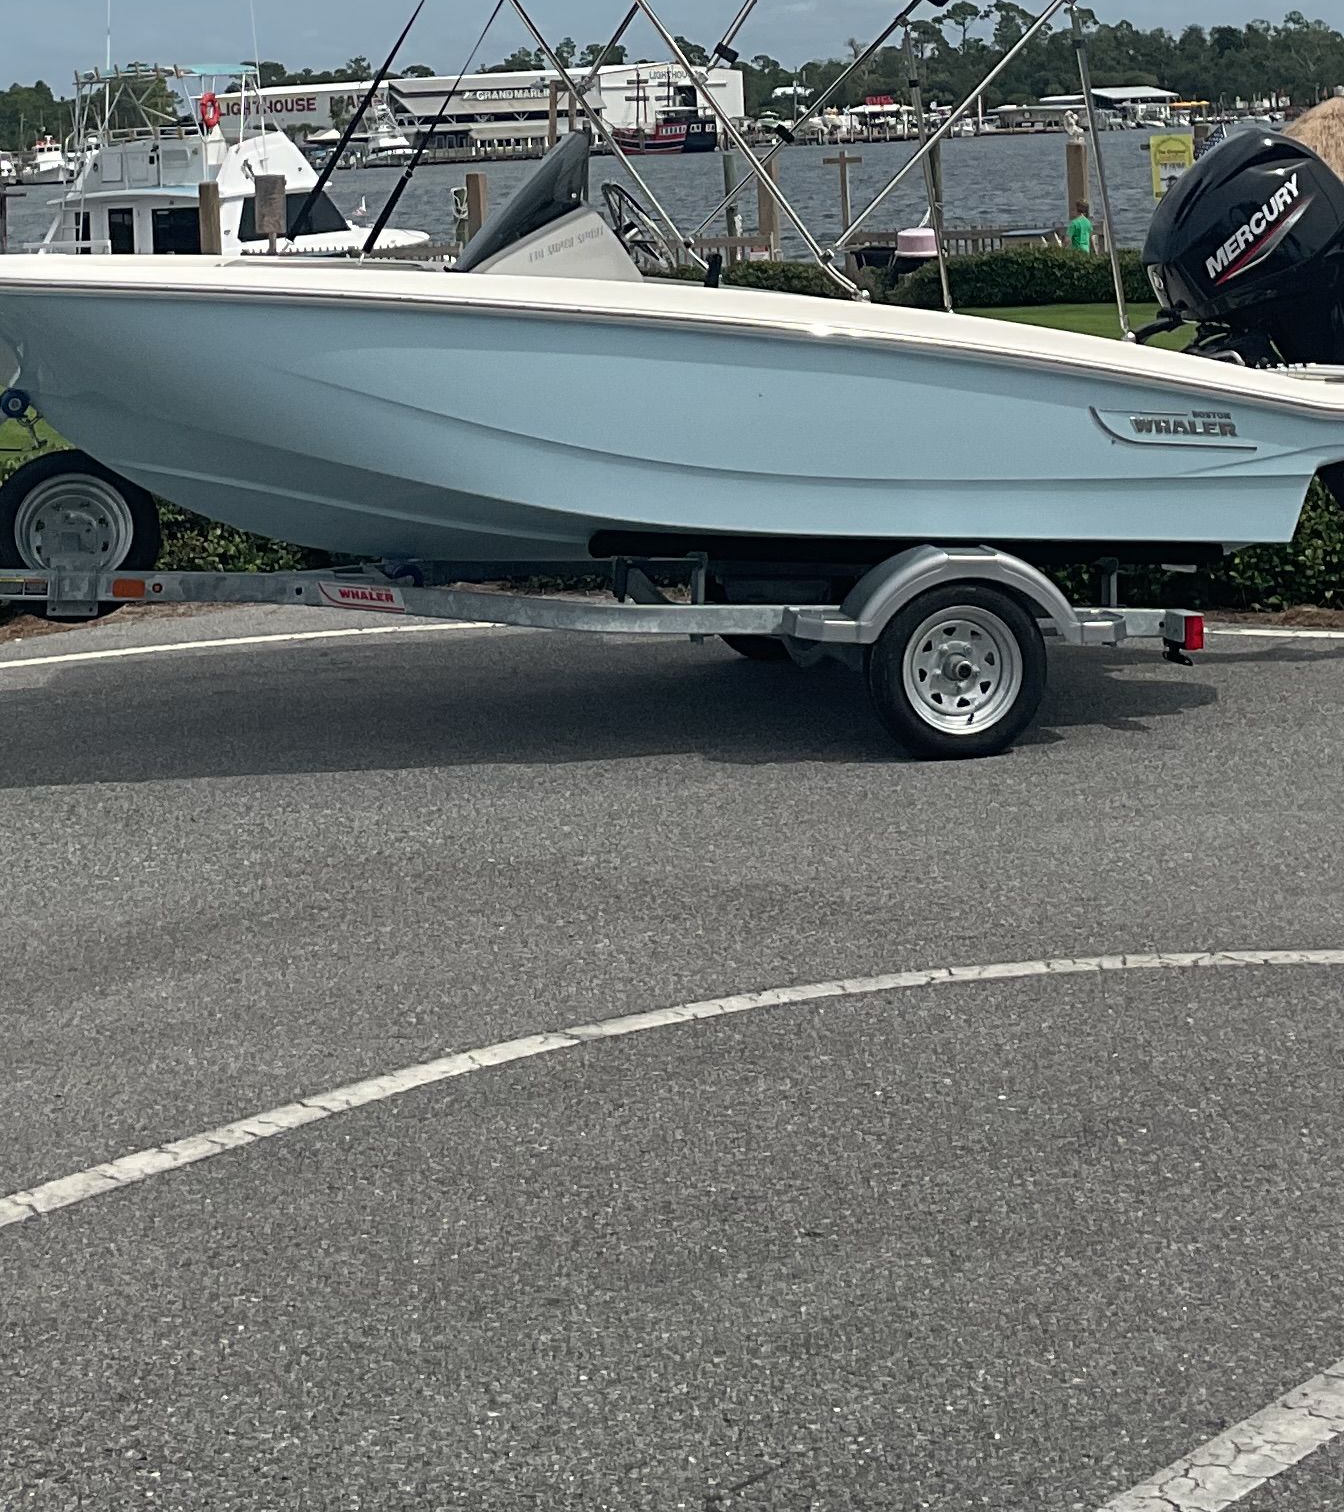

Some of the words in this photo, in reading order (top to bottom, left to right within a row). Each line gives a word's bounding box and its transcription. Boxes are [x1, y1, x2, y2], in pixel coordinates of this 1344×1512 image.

[476, 89, 513, 101] GRAND
[1205, 173, 1299, 279] MERCURY
[1191, 410, 1232, 420] BOSTON
[1129, 416, 1239, 437] WHALER
[338, 589, 394, 603] WHALER
